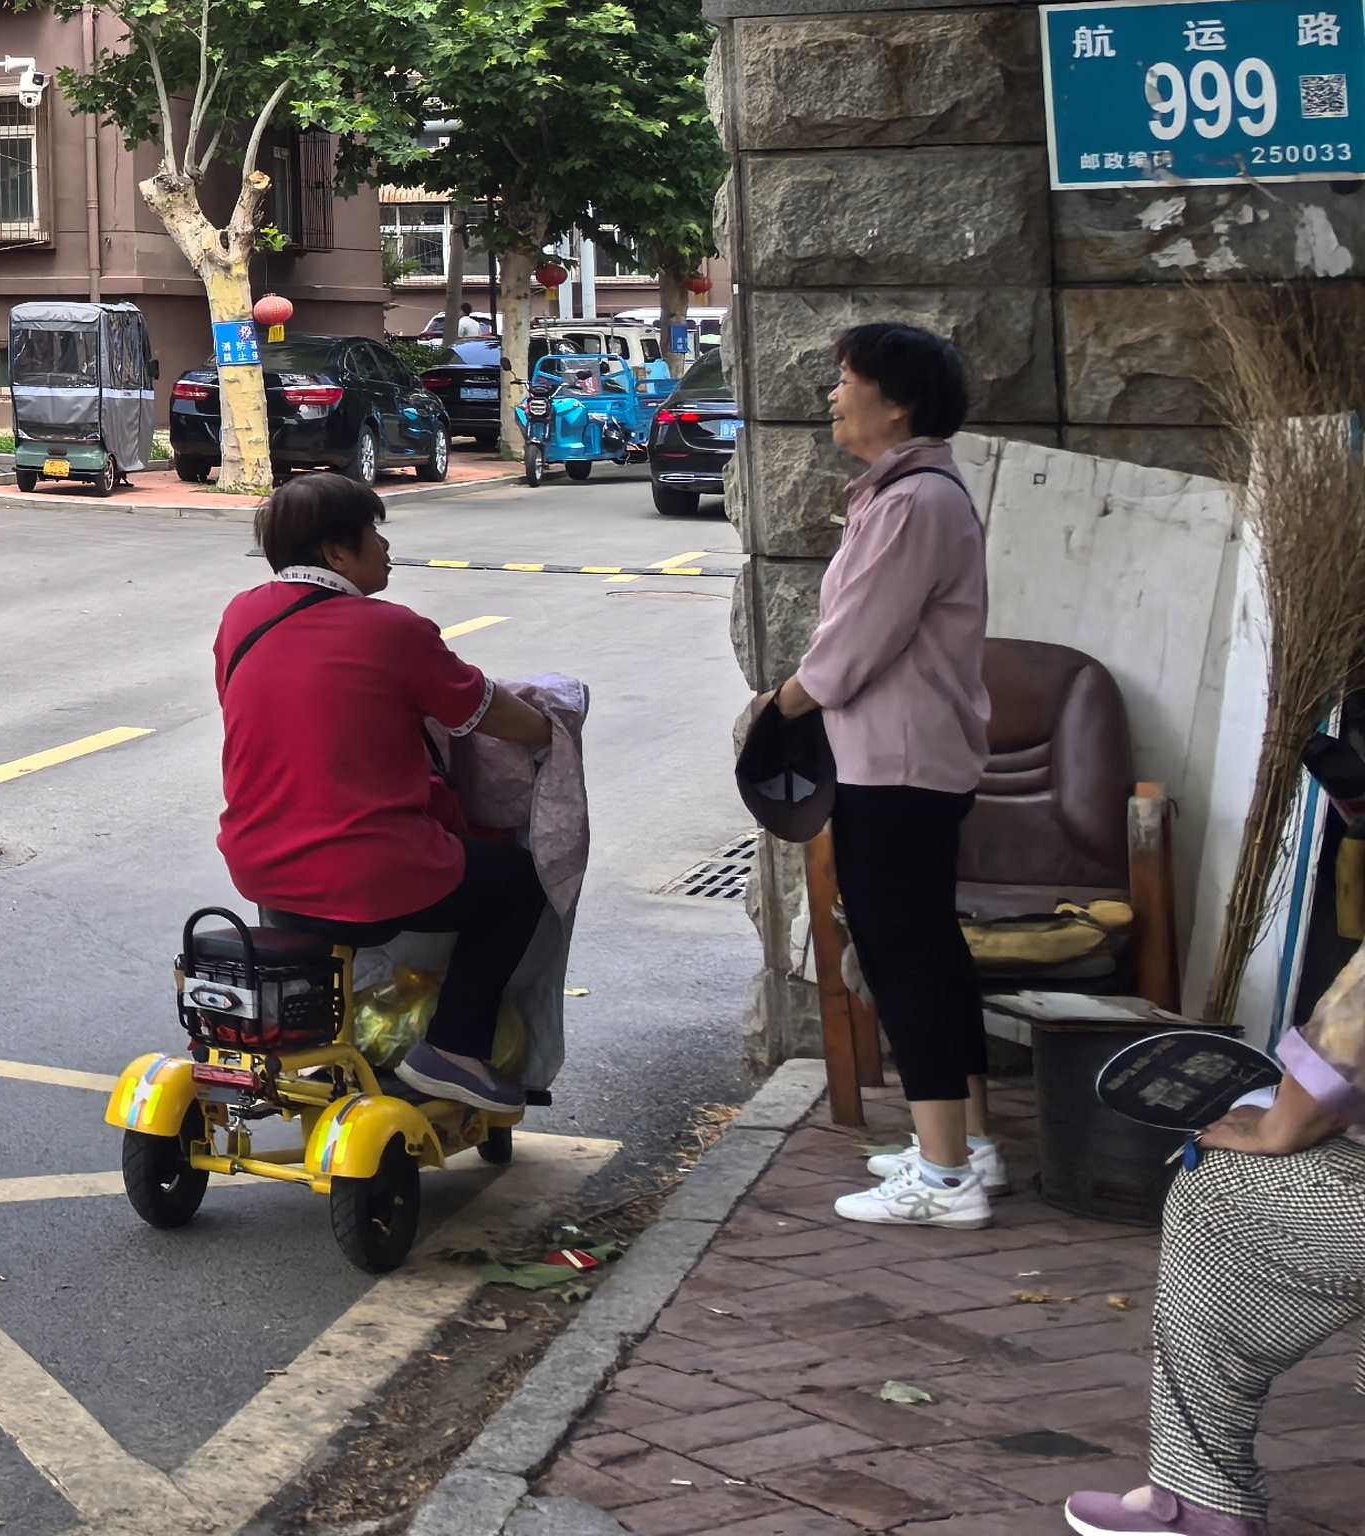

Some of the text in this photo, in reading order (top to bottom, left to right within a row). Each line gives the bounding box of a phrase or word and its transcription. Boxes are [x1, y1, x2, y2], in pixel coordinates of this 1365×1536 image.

[1072, 12, 1341, 59] 航运路
[1144, 57, 1278, 141] 999
[1079, 143, 1352, 170] 邮政编码 250033
